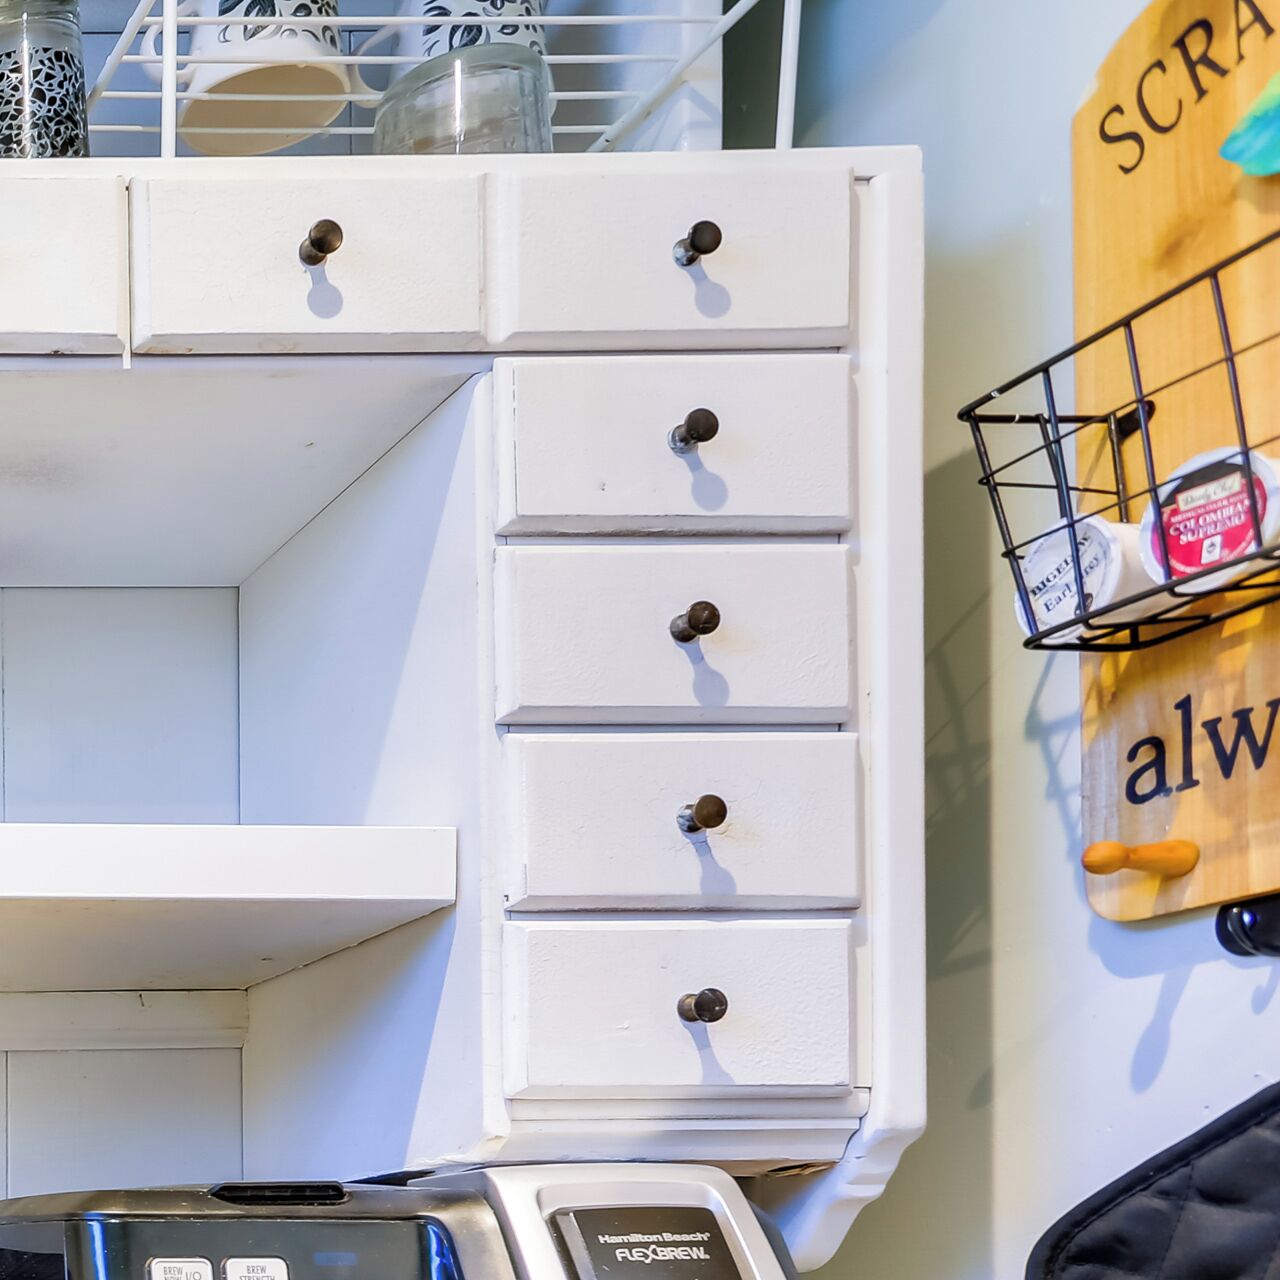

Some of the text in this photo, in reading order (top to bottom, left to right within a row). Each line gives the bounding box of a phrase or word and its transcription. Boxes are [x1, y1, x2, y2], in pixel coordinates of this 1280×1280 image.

[1098, 0, 1276, 175] SCRA
[1029, 531, 1091, 598] BIGELW
[1043, 583, 1072, 613] Earl
[1125, 693, 1280, 805] alw
[598, 1232, 662, 1244] Hamilton
[163, 1266, 183, 1276] BREW
[246, 1265, 267, 1275] BREW
